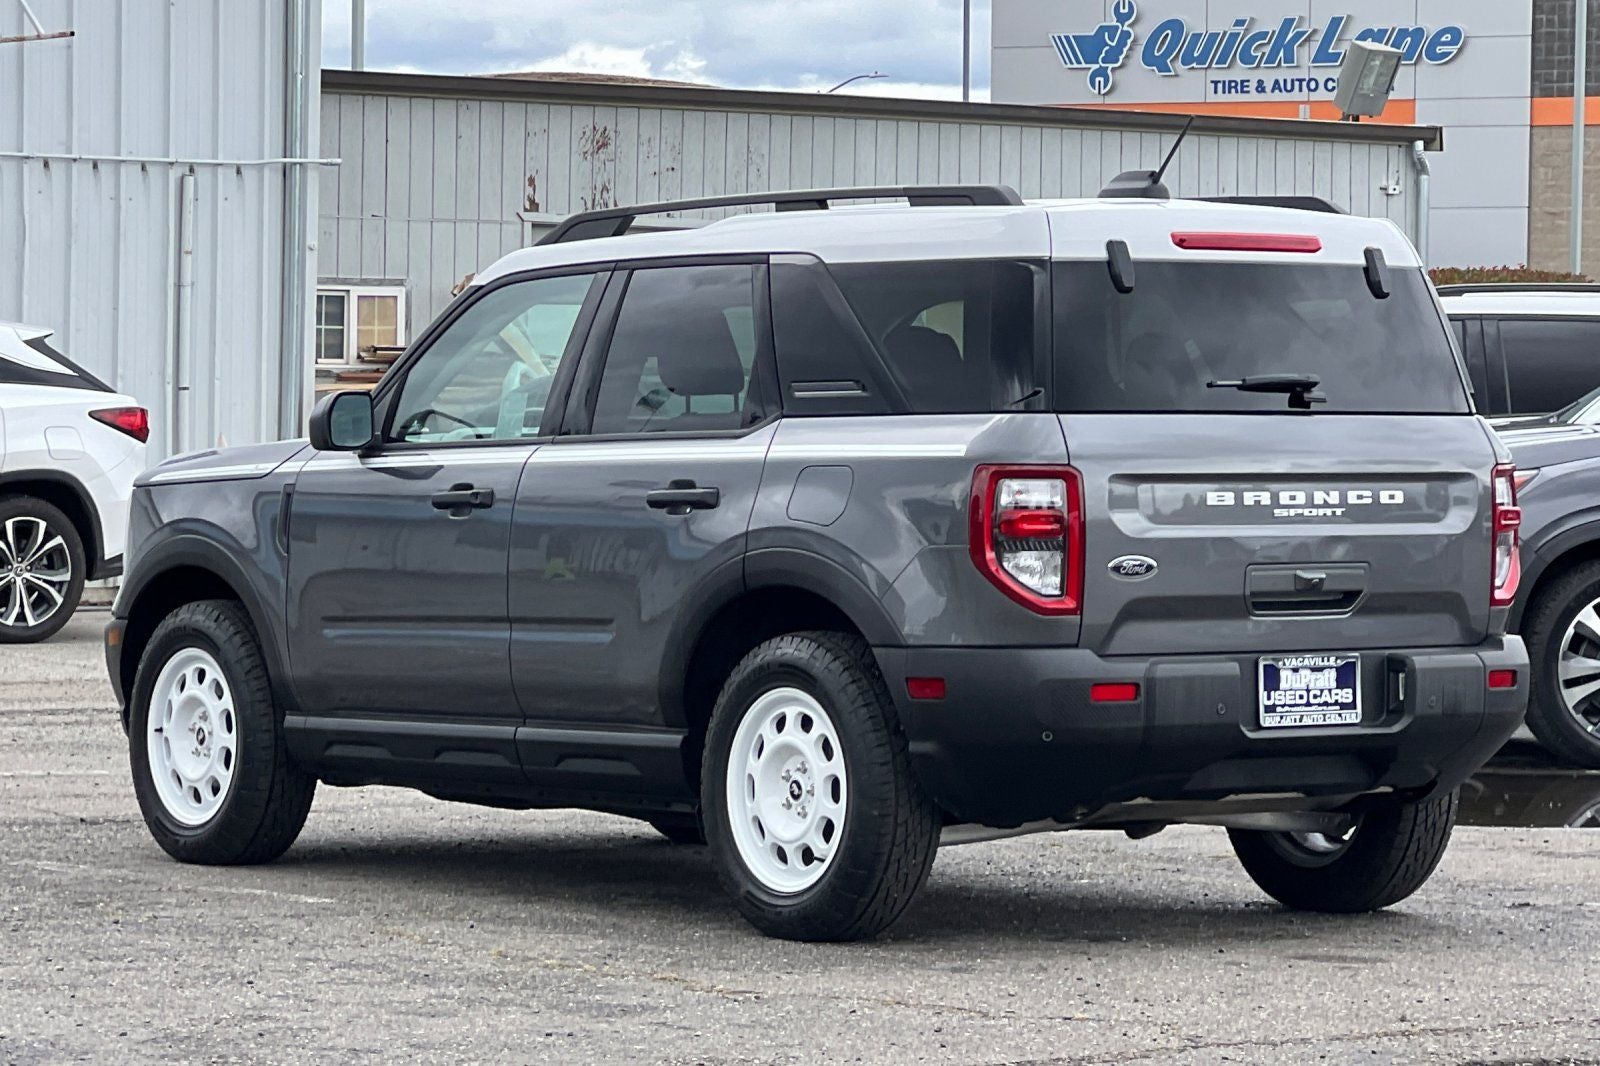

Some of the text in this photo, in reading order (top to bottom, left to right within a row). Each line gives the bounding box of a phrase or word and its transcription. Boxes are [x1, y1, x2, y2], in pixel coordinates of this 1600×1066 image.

[1141, 17, 1309, 75] Quick
[1210, 79, 1250, 95] TIRE
[1255, 80, 1266, 94] &
[1271, 78, 1320, 94] AUTO
[1206, 490, 1404, 506] BRONCO
[1273, 508, 1346, 517] SPORT
[1120, 560, 1148, 574] Ford
[1284, 657, 1336, 667] VACAVILLE
[1280, 668, 1336, 690] DuPratt
[1264, 689, 1353, 705] USED CARS
[1302, 714, 1324, 723] AUTO
